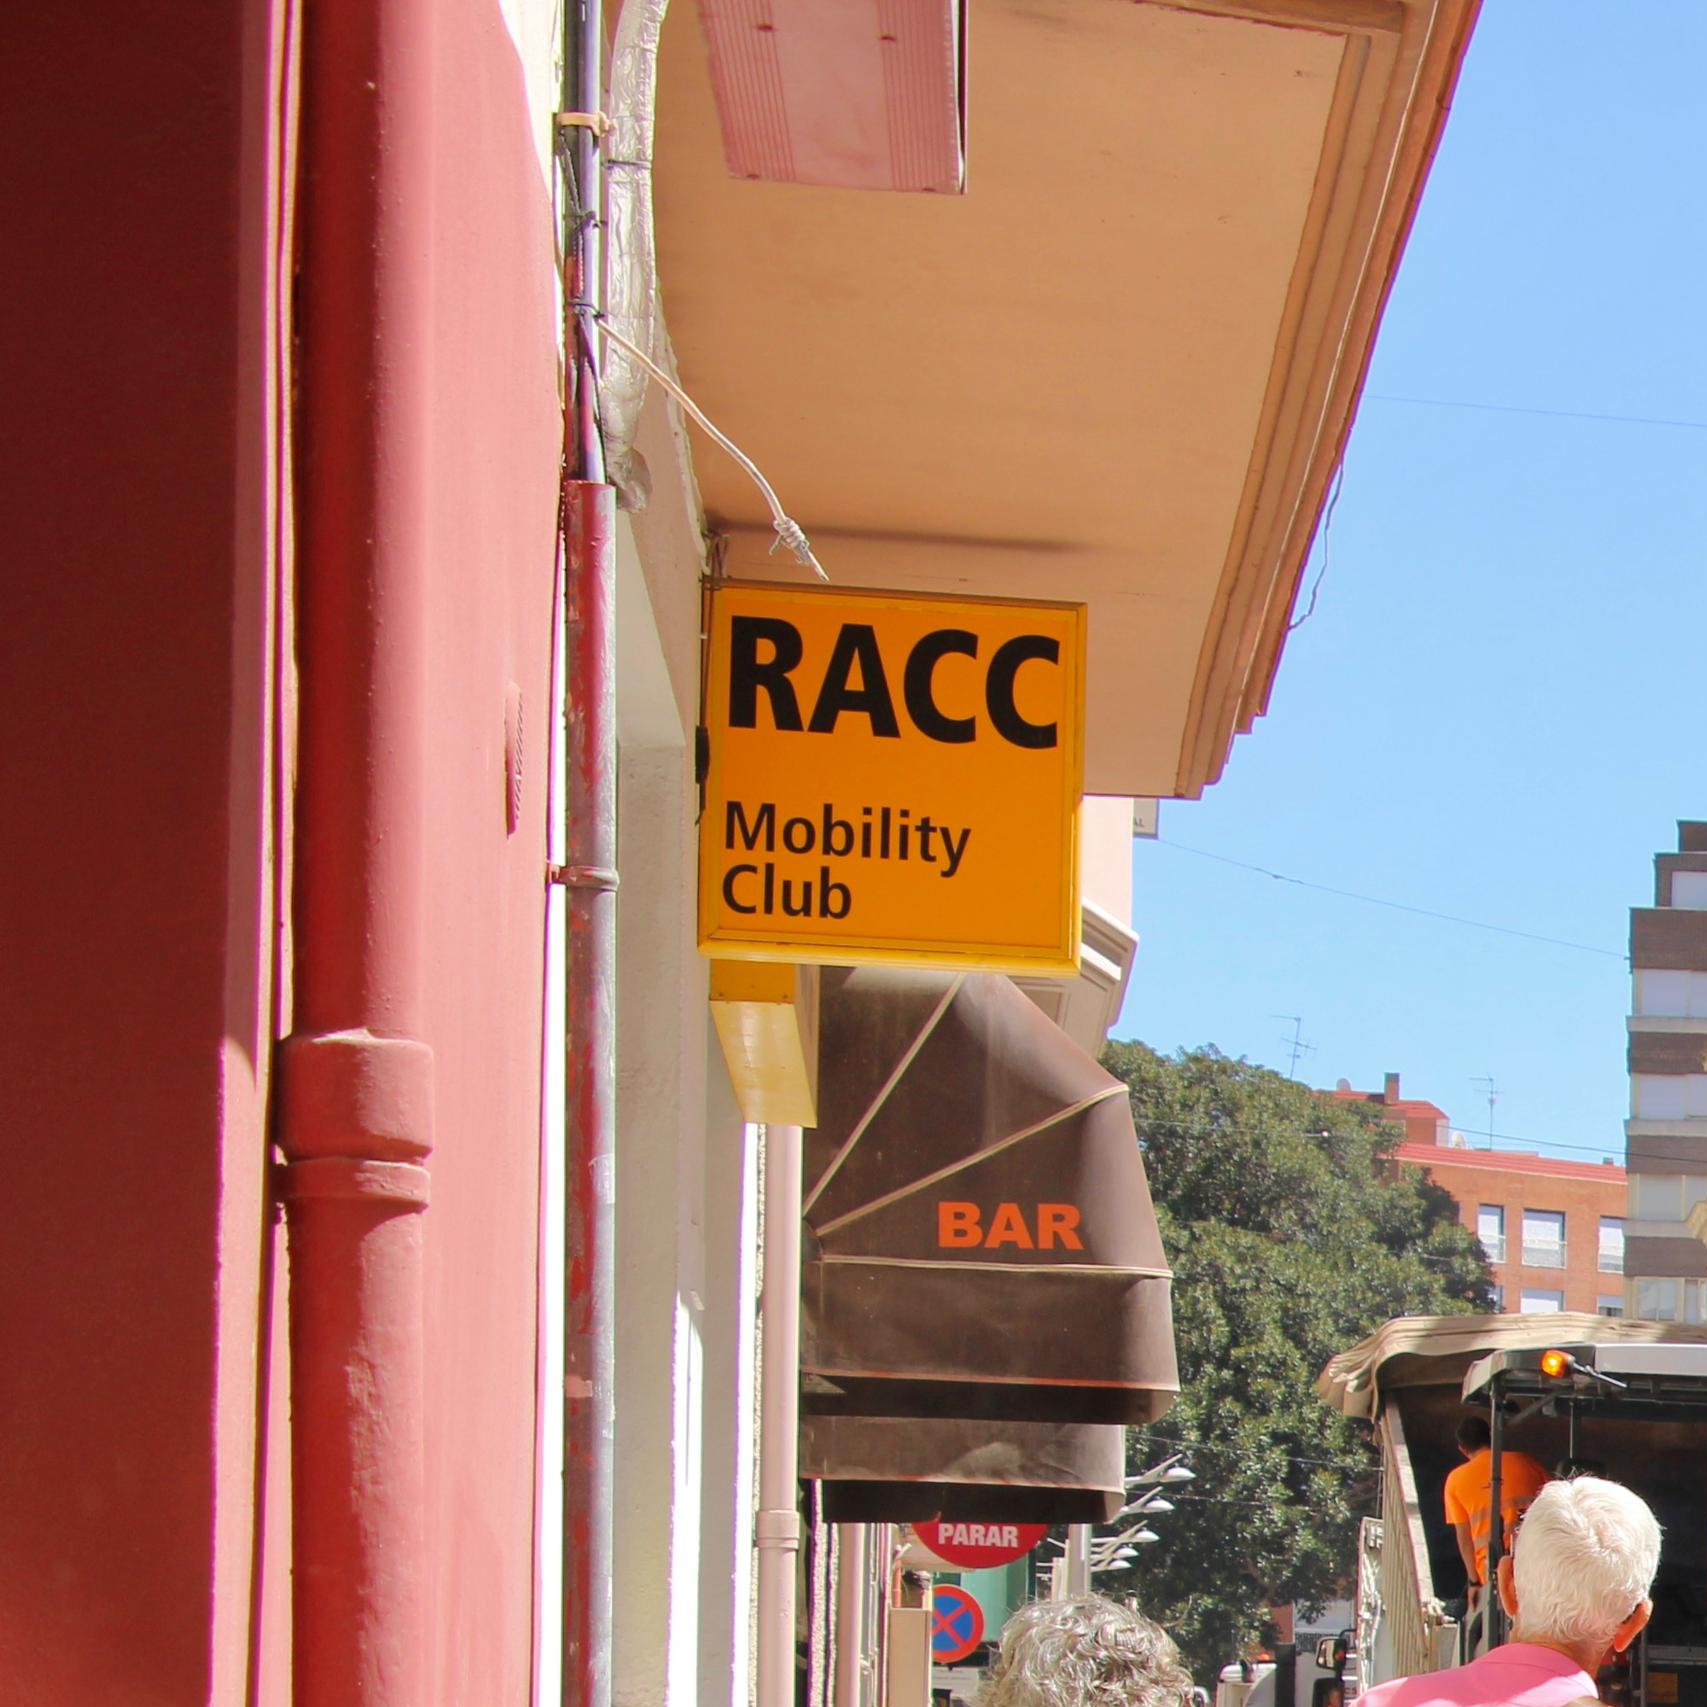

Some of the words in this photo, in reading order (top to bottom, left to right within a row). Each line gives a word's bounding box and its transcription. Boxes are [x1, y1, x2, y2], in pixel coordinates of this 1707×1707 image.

[728, 615, 1060, 749] RACC
[724, 801, 972, 878] Mobility
[722, 862, 852, 920] Club
[938, 1201, 1084, 1250] BAR
[938, 1523, 1019, 1548] PARAR
